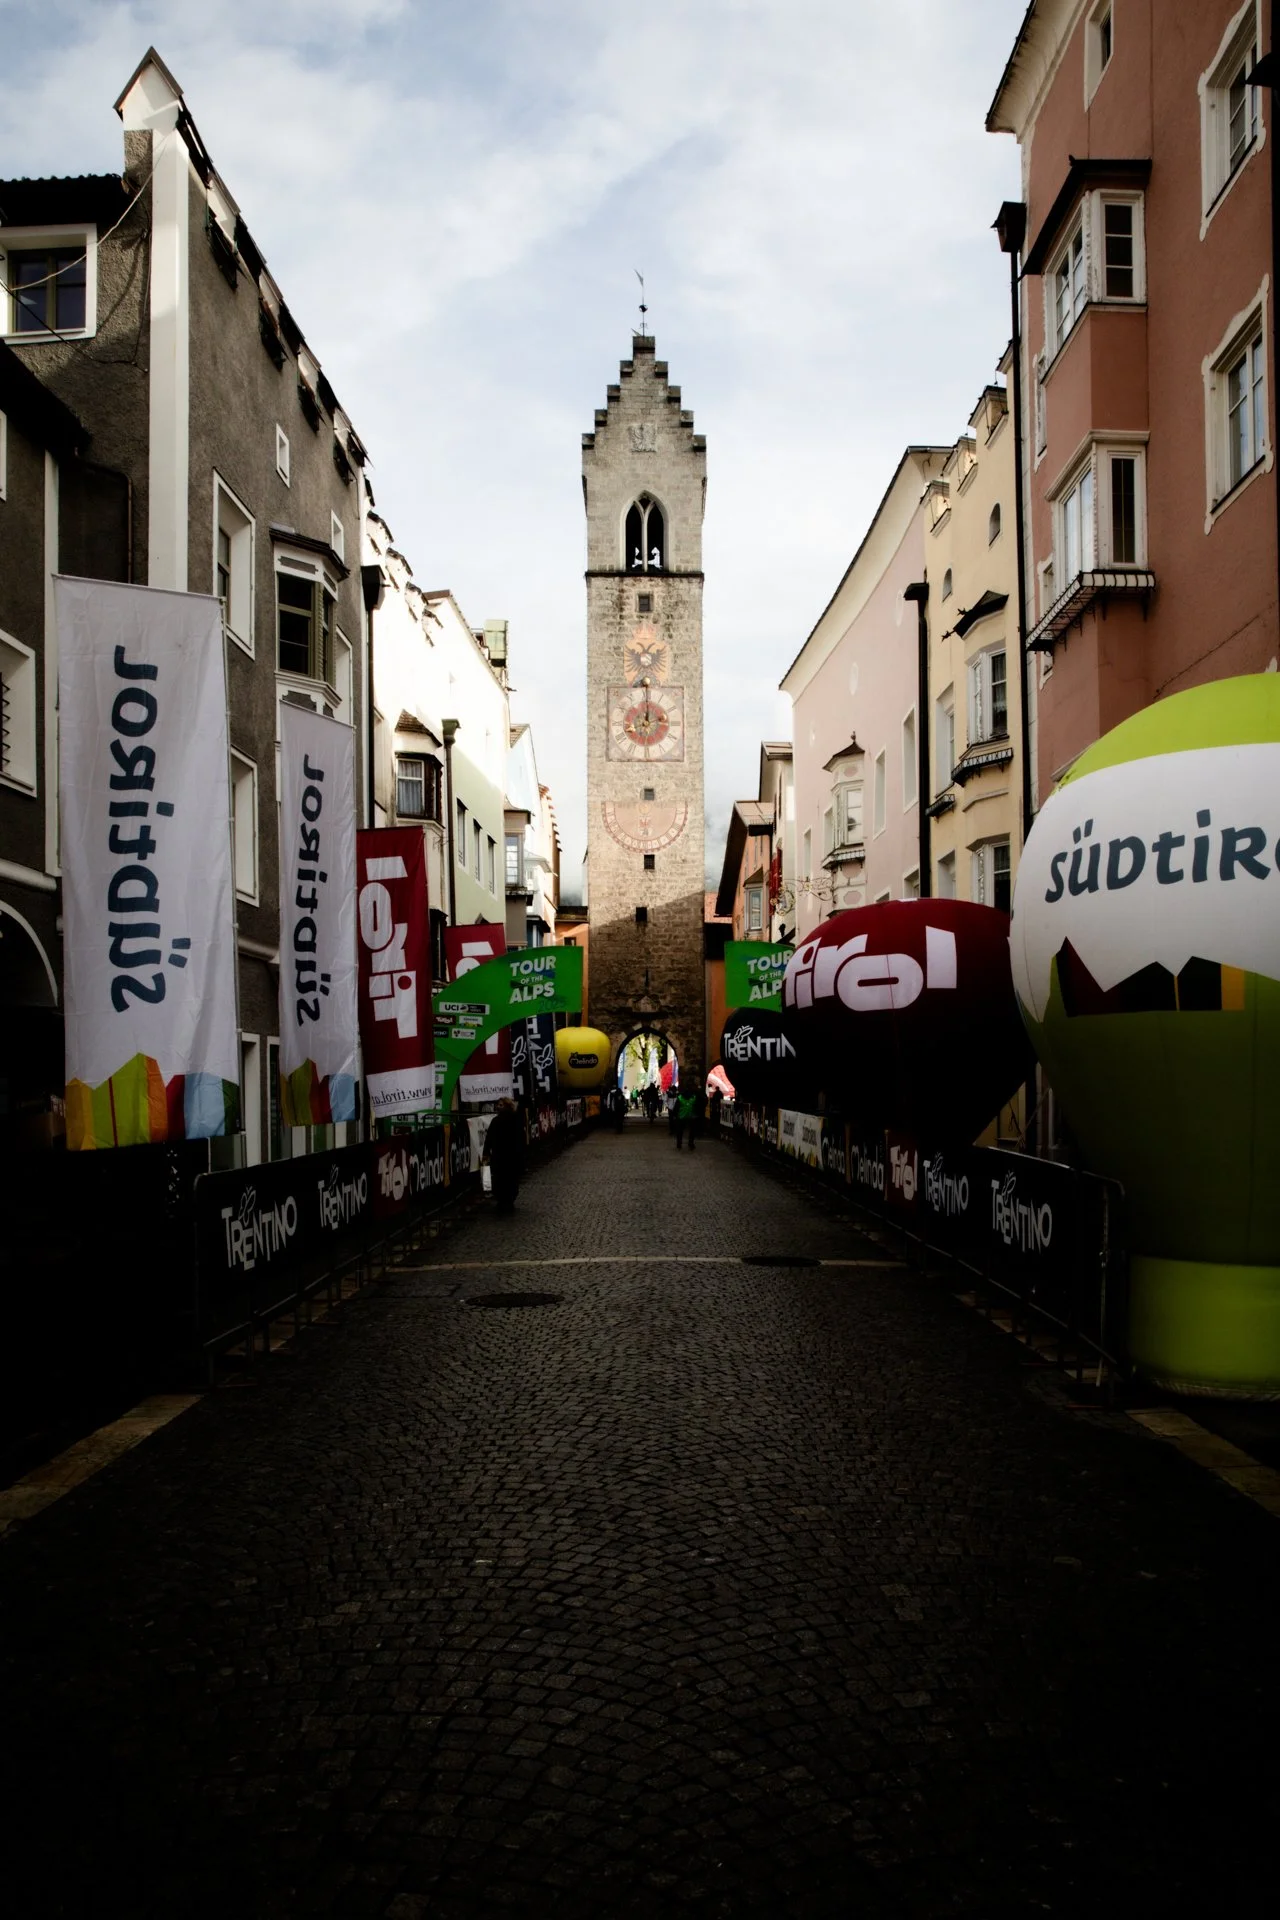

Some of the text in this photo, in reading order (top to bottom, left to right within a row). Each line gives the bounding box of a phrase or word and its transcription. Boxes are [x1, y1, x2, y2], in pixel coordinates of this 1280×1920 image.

[509, 982, 555, 1004] ALPS
[510, 955, 557, 977] TOUR
[748, 980, 782, 1002] ALP
[317, 1172, 367, 1231] TRENTINO
[923, 1160, 970, 1217] TRENTINO
[221, 1196, 298, 1271] TRENTINO
[991, 1179, 1053, 1256] TRENTINO
